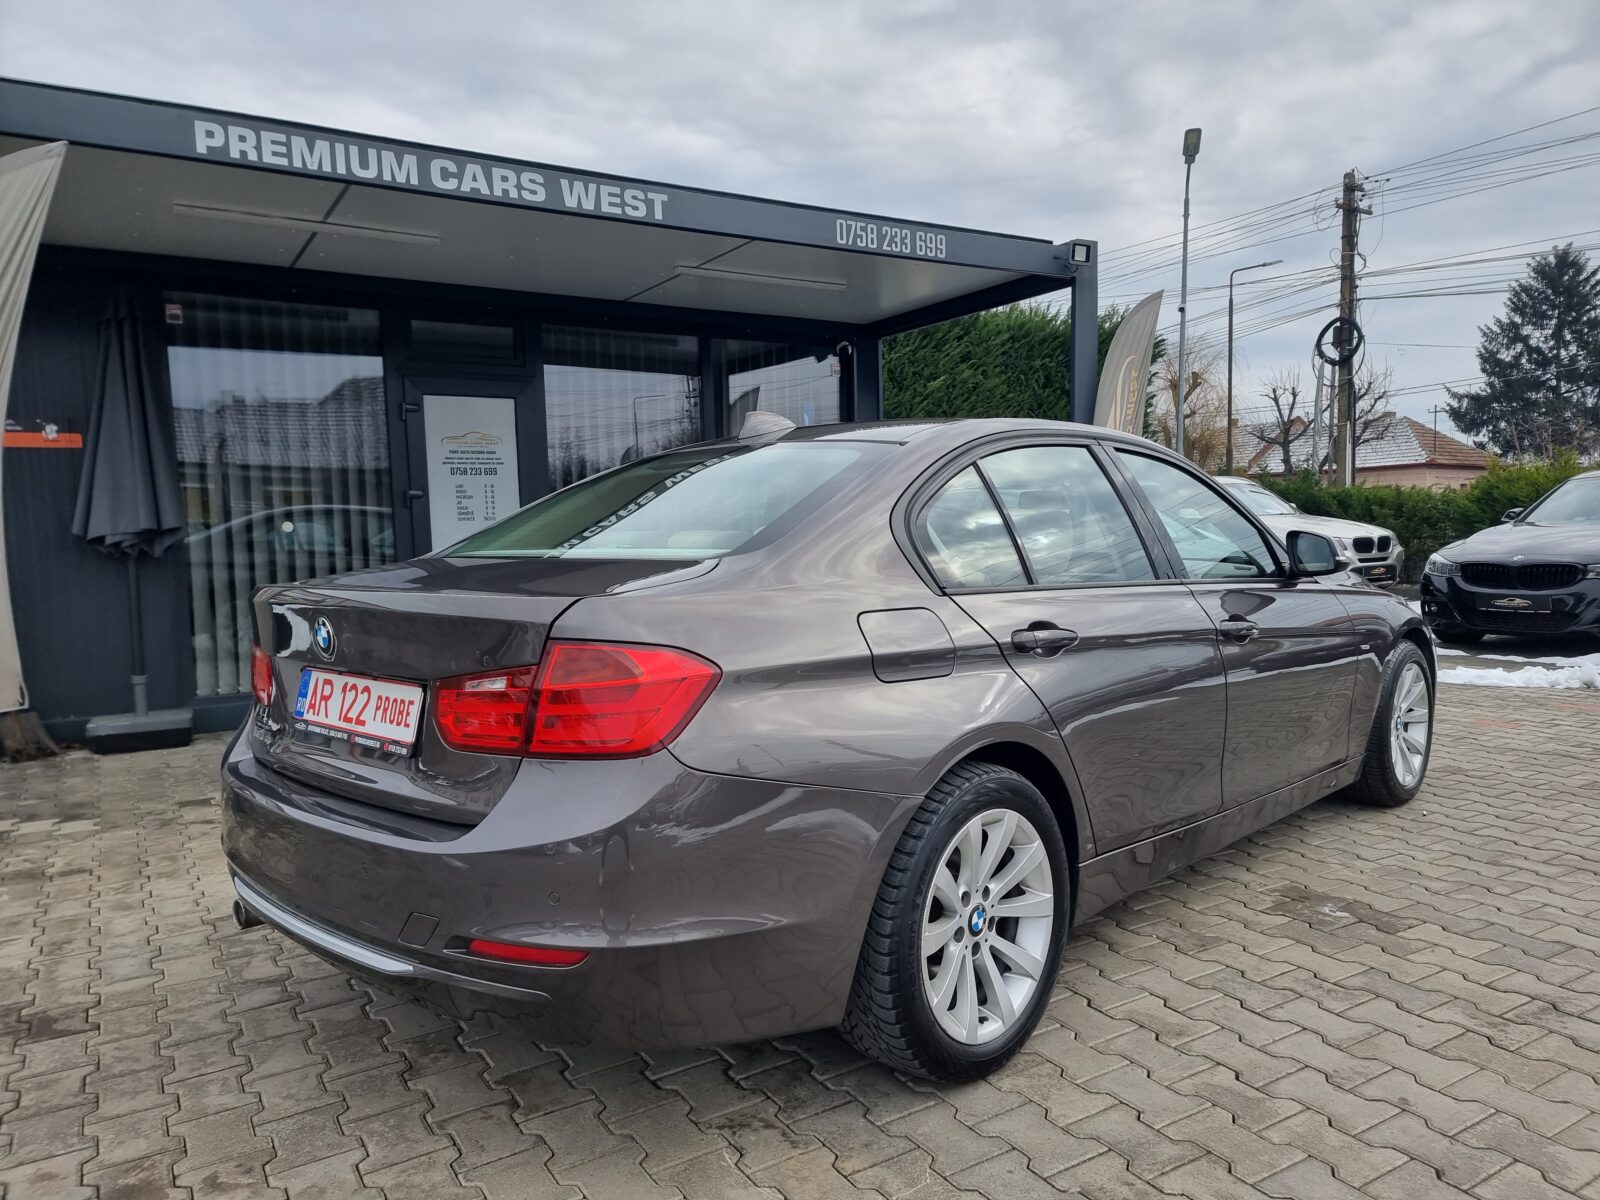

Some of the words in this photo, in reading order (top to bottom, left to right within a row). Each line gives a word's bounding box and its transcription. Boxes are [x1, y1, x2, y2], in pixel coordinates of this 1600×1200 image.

[193, 119, 419, 186] PREMIUM
[430, 158, 547, 202] CARS
[559, 177, 669, 221] WEST
[836, 219, 878, 249] 0758
[881, 226, 911, 254] 233
[916, 231, 946, 258] 699
[450, 467, 468, 476] 0758
[469, 467, 483, 476] 233
[483, 467, 498, 476] 699
[296, 696, 307, 713] RO
[306, 676, 334, 719] AR
[338, 681, 372, 727] 122
[373, 695, 415, 728] PROBE
